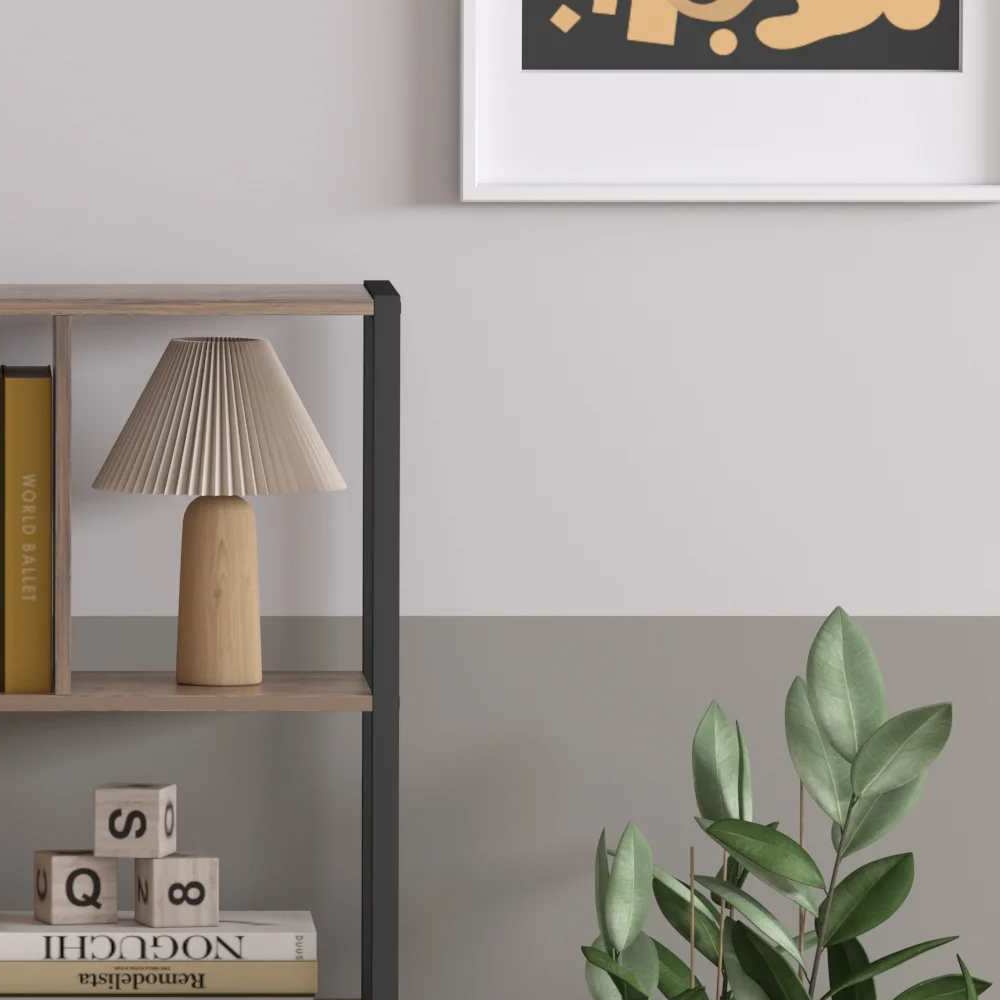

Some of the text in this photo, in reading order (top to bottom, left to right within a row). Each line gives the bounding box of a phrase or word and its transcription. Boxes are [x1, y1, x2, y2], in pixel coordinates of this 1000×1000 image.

[21, 474, 38, 602] WORLD BALLET
[108, 808, 147, 840] S
[65, 867, 102, 910] Q
[168, 880, 206, 906] 8
[42, 935, 244, 960] NOGUCHI
[78, 972, 206, 990] Remodelista
